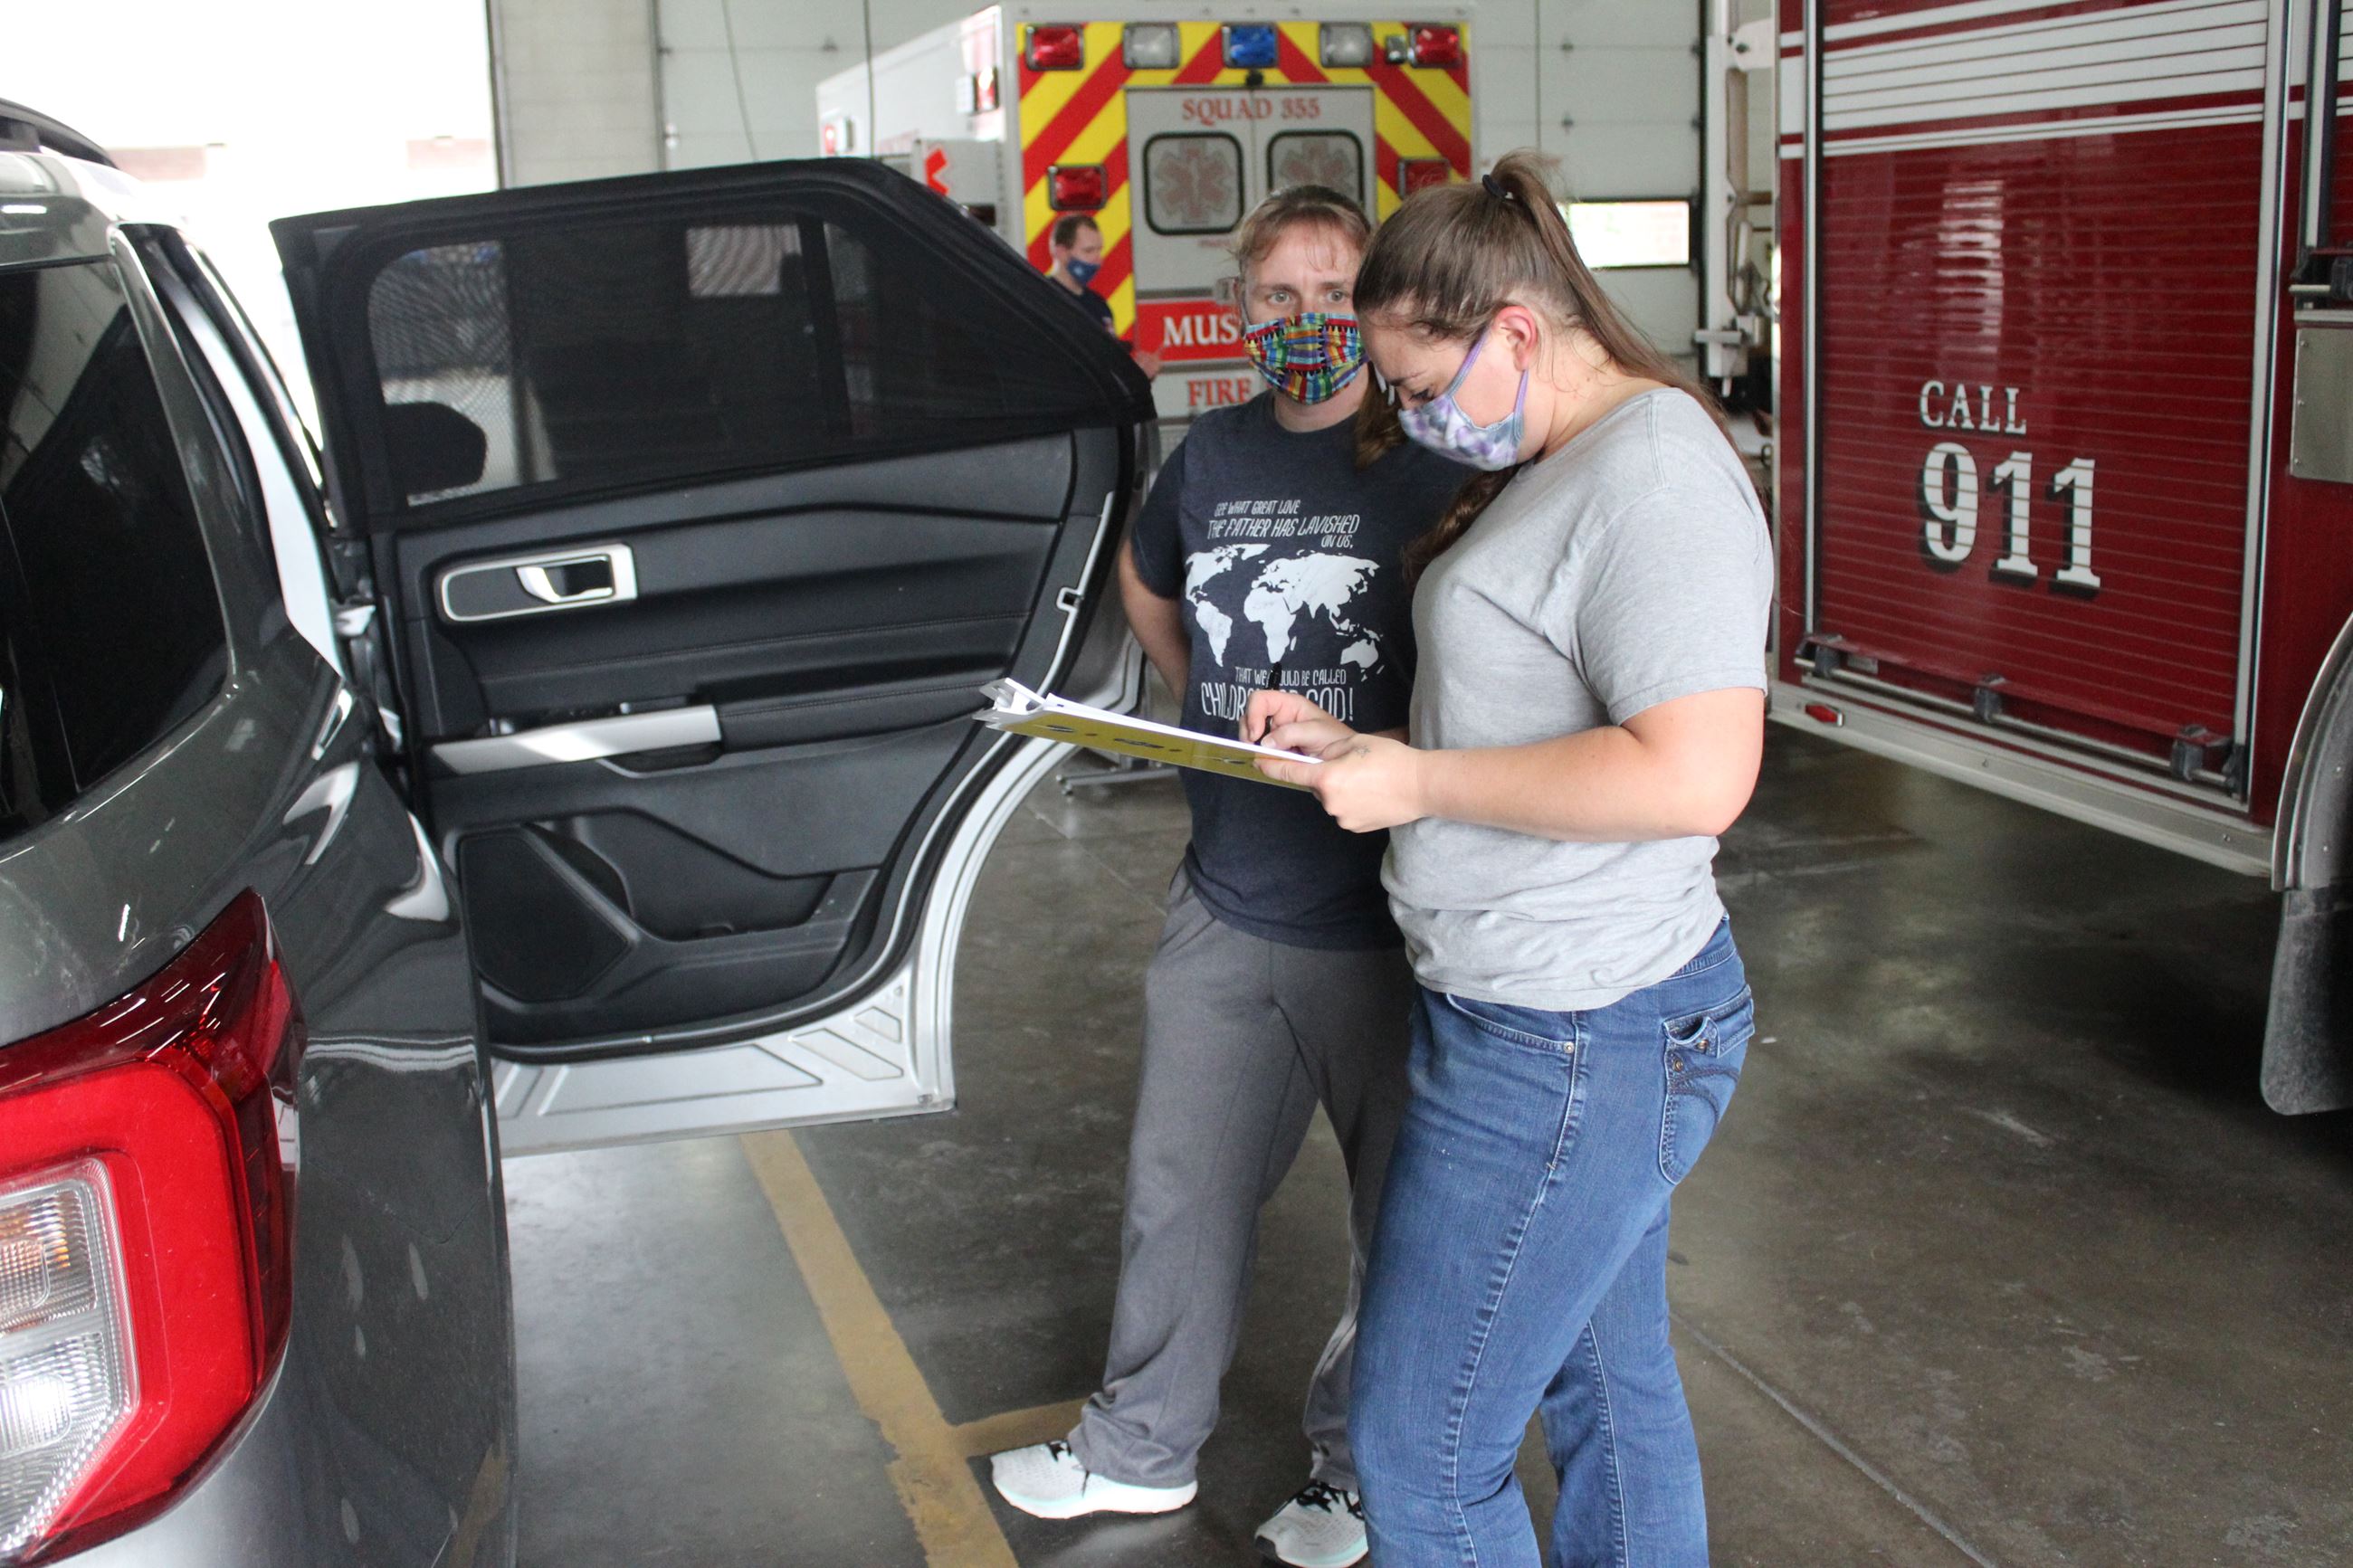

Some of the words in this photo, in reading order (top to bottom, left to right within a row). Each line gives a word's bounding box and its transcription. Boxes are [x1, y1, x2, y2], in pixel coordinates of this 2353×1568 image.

[1182, 98, 1272, 126] SQUAD
[1163, 313, 1239, 347] MUS
[1187, 376, 1252, 406] FIRE
[1920, 380, 2026, 434] CALL
[1228, 500, 1252, 515] WHAT
[1252, 500, 1278, 515] GREAT
[1277, 499, 1301, 515] LOVE
[1920, 442, 2101, 590] 911
[1207, 519, 1226, 539] THE
[1224, 518, 1272, 537] FATHER
[1271, 518, 1299, 537] HAS
[1297, 514, 1360, 537] LAVISHED
[1321, 535, 1337, 548] ON
[1235, 667, 1253, 684] THAT
[1254, 669, 1266, 685] WE
[1301, 670, 1310, 687] BE
[1312, 669, 1347, 687] CALLED
[1201, 682, 1258, 721] CHILDR
